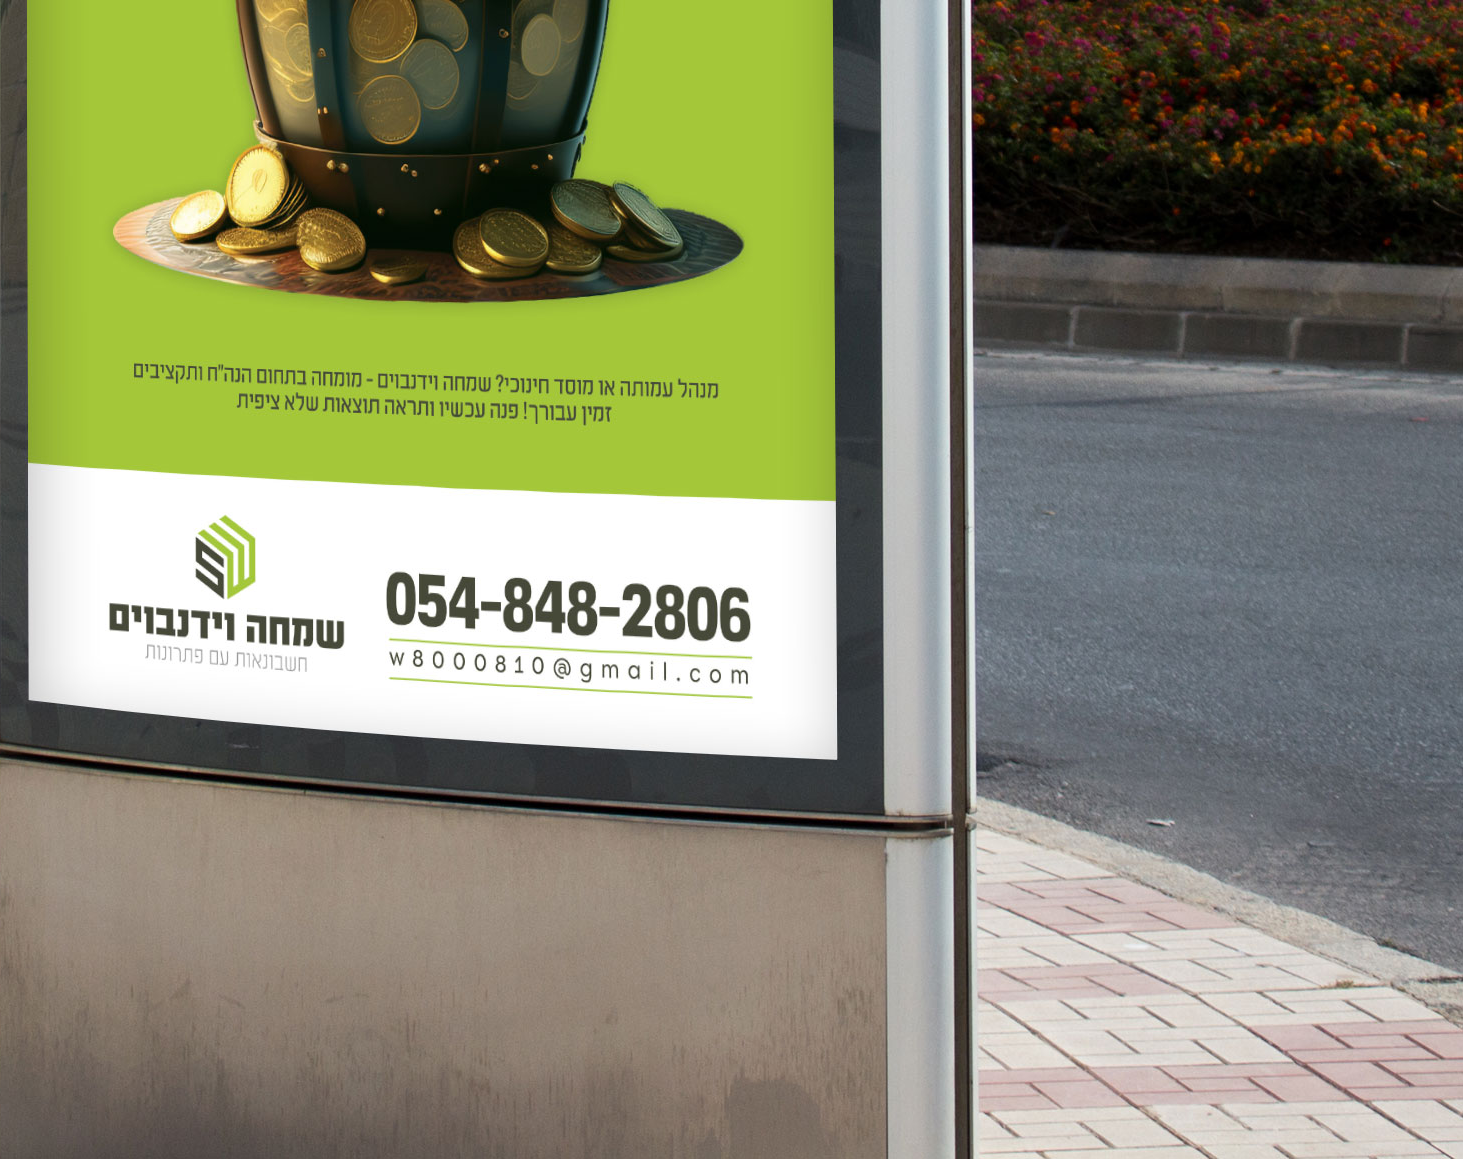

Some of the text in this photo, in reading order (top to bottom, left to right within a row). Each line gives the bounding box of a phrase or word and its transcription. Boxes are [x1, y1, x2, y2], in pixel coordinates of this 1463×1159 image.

[133, 362, 203, 385] ותקציבים
[256, 368, 308, 386] בתחום
[311, 370, 363, 389] מומחה
[377, 372, 439, 392] וידנבוים
[442, 375, 492, 393] שמחה
[494, 373, 550, 396] חינוכי?
[553, 378, 594, 396] מוסד
[597, 379, 616, 397] או
[619, 380, 674, 398] עמותה
[677, 377, 719, 399] מנהל
[236, 391, 613, 427] זמין עבורך! פנה עכשיו ותראה תוצאות שלא ציפית
[385, 571, 752, 643] 054-848-2806
[108, 602, 345, 650] שמחה וידנבוים
[144, 643, 308, 673] חשבונאות עם פתרונות
[388, 649, 749, 685] w8000810@gmail.com
